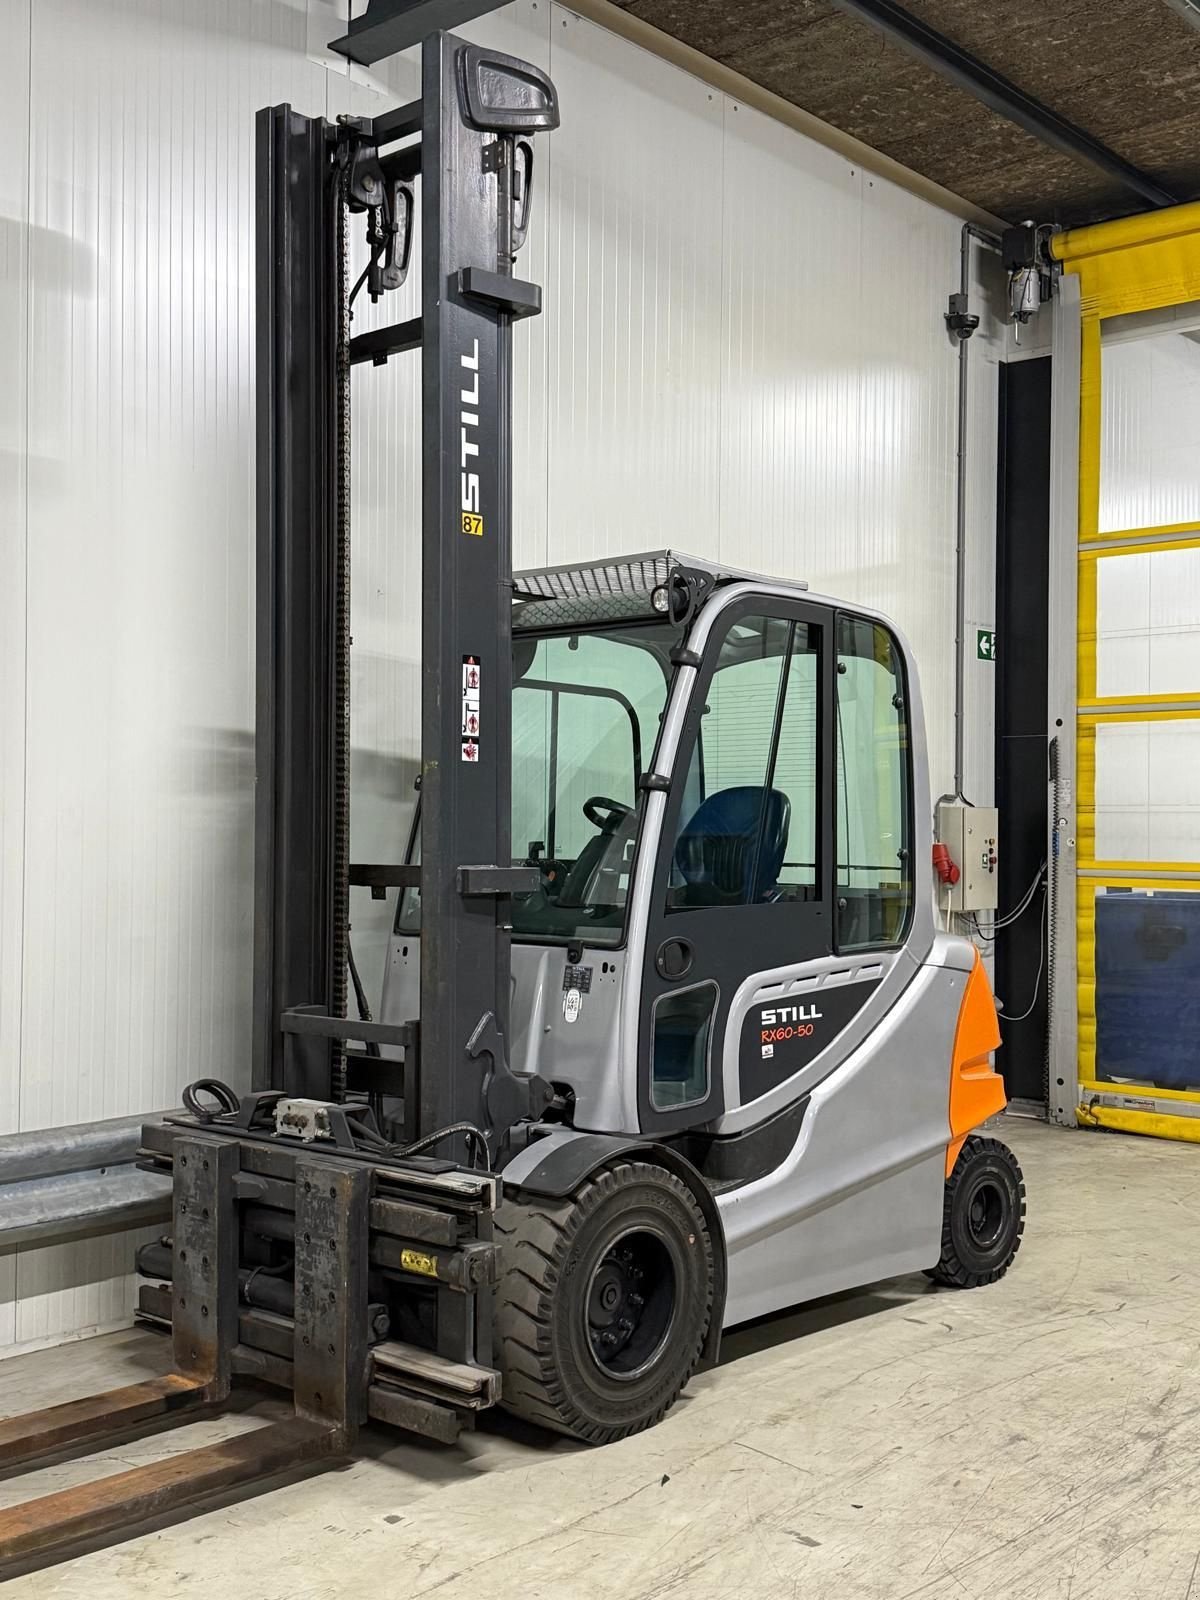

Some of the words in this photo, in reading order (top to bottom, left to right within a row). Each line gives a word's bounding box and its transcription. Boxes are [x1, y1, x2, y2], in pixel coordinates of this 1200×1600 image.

[461, 338, 479, 513] STILL
[463, 515, 482, 533] 87
[761, 1004, 823, 1026] STILL
[761, 1023, 814, 1043] RX60-50
